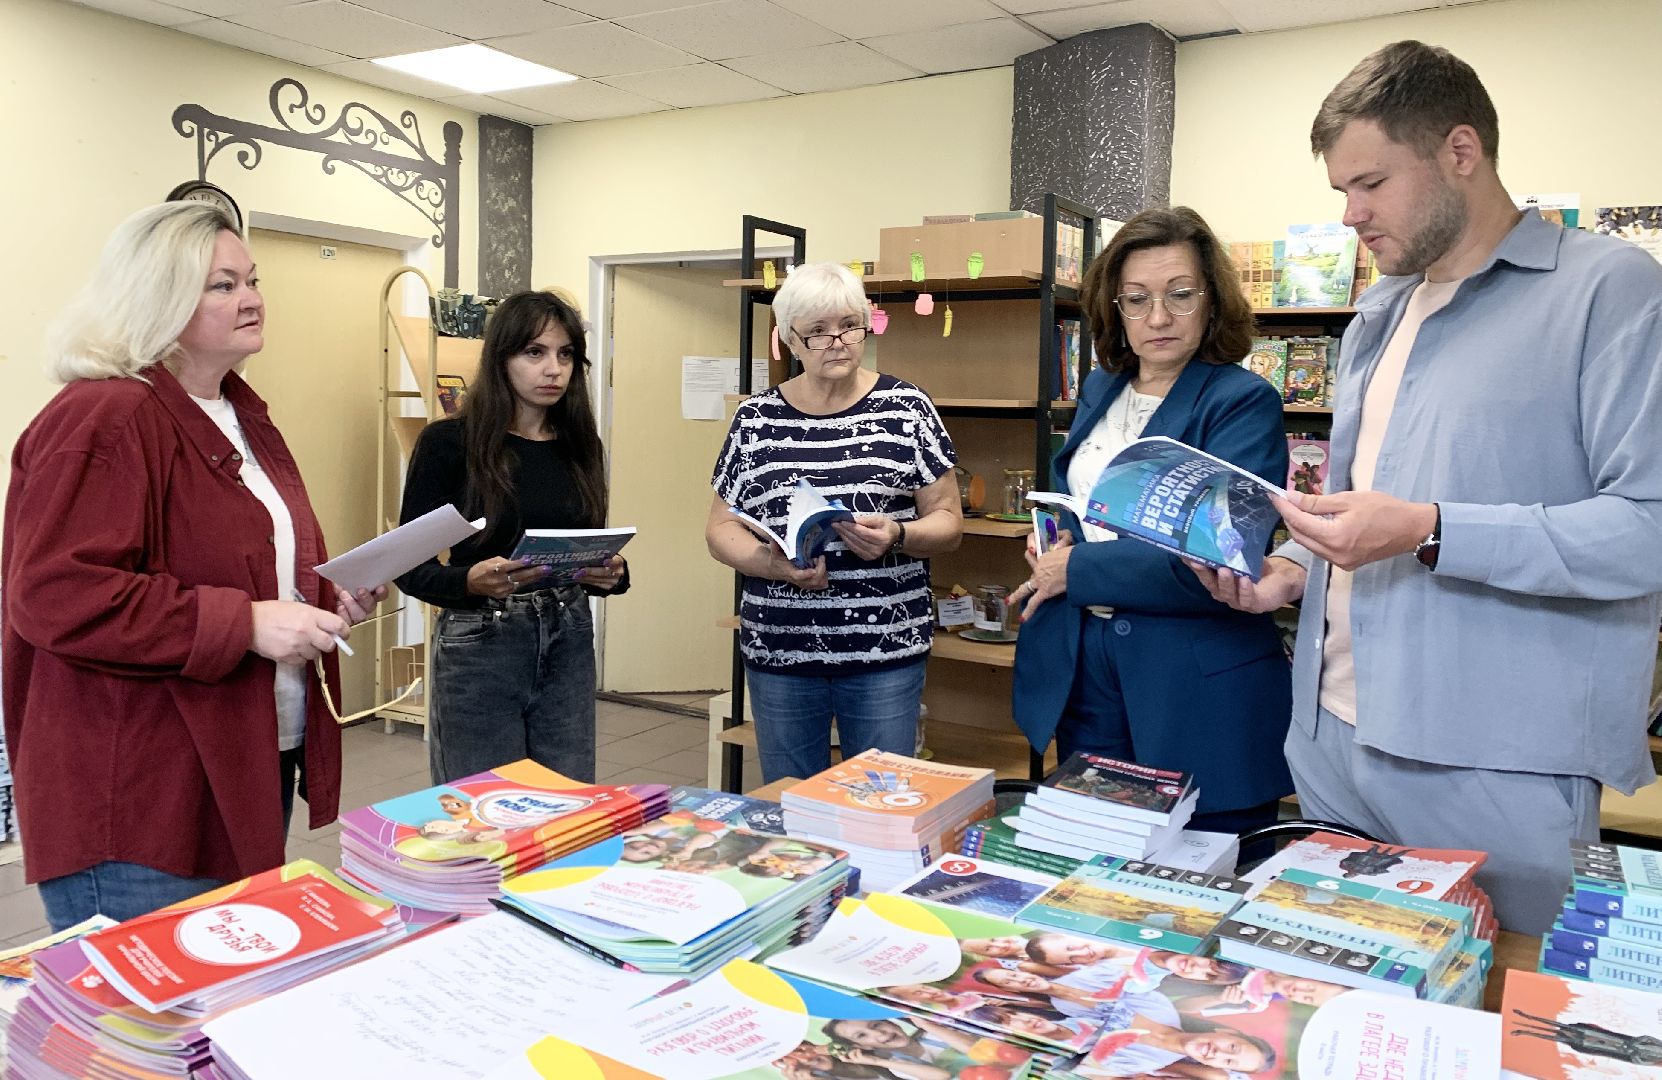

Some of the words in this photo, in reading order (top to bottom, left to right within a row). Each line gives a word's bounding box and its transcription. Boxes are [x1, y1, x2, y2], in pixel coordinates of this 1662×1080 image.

[322, 248, 336, 257] 120
[1132, 474, 1161, 524] МАТЕМАТИКА
[1157, 520, 1174, 536] И
[1097, 757, 1158, 775] ИСТОРИЯ
[882, 791, 924, 806] 6
[1162, 786, 1180, 795] 6
[1080, 867, 1220, 902] ЛИТЕРАТУРА
[205, 924, 253, 953] ДРУЗЬЯ
[214, 909, 241, 923] МЫ
[245, 932, 281, 954] ТВОИ
[1138, 929, 1164, 940] 9
[1256, 912, 1418, 960] ЛИТЕРАТУРА
[1366, 1012, 1385, 1020] В
[1360, 1021, 1384, 1060] ЛАГЕРЕ
[1388, 1033, 1408, 1056] ДВЕ
